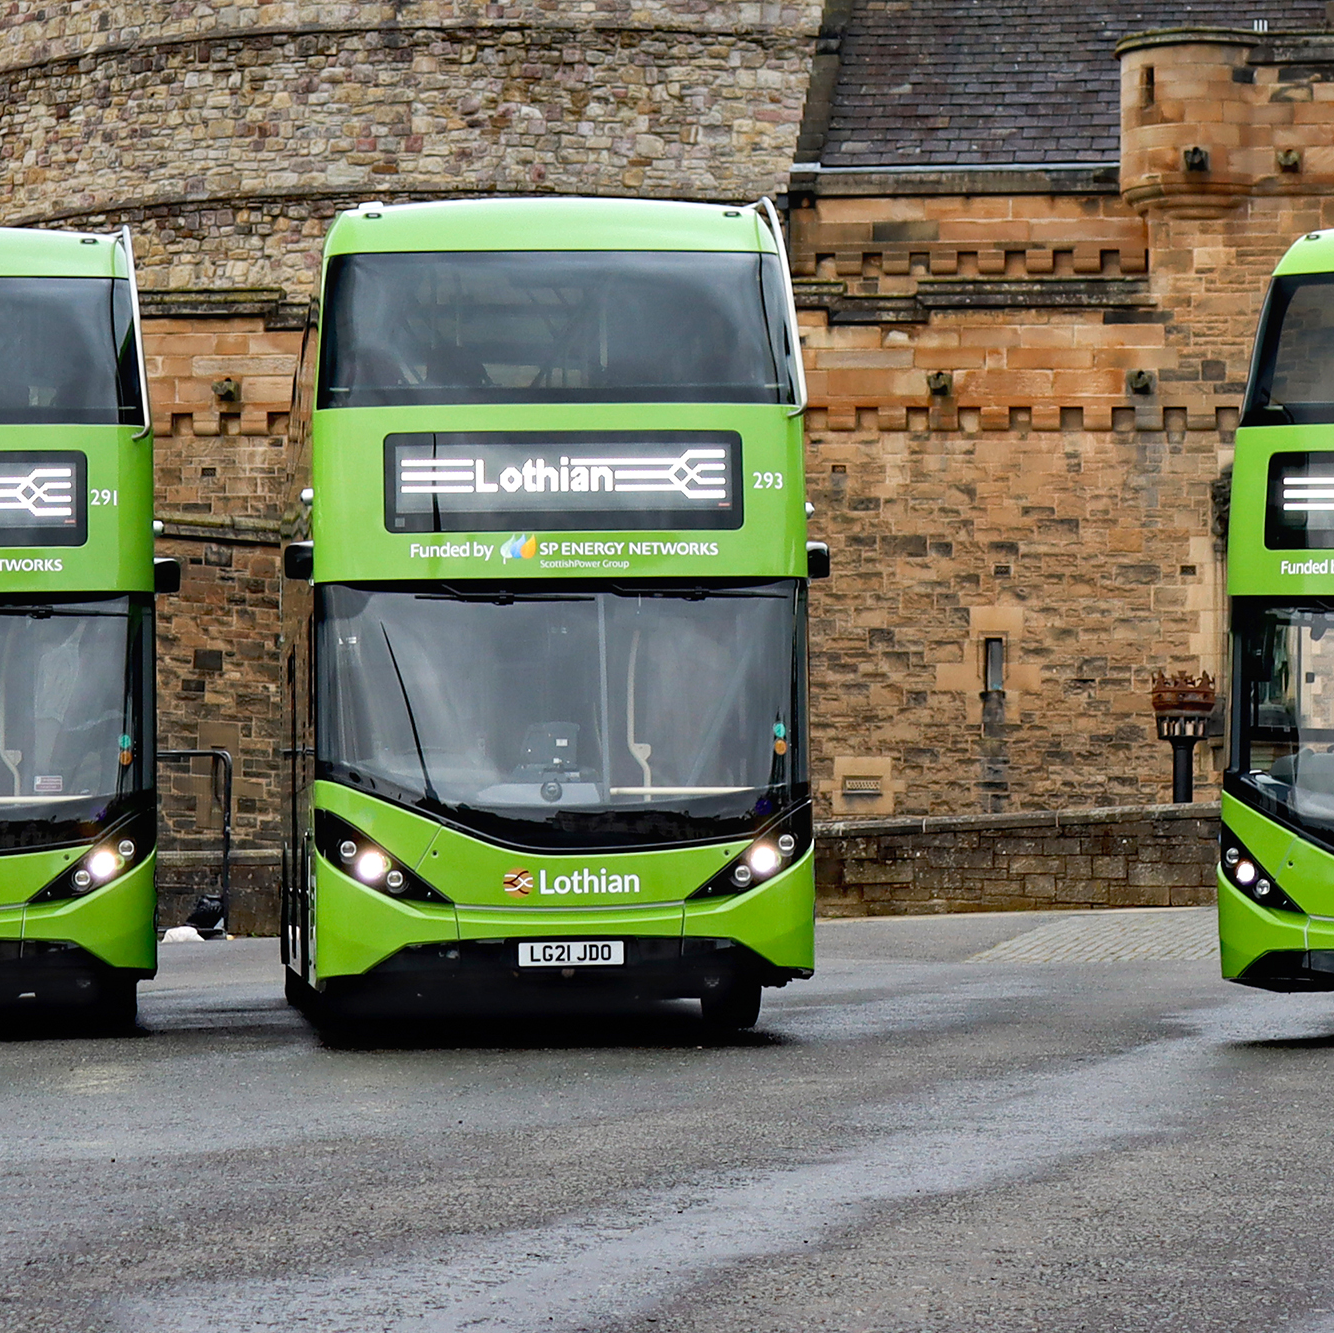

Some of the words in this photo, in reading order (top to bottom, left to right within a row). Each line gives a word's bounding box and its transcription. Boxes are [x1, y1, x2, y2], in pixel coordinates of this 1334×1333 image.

[475, 456, 616, 493] Lothian
[752, 471, 784, 490] 293
[90, 488, 119, 506] 291
[410, 541, 471, 558] Funded
[472, 541, 495, 562] by
[539, 541, 559, 556] SP
[560, 541, 626, 556] ENERGY
[628, 541, 719, 556] NETWORKS
[539, 559, 601, 569] ScottishPower
[601, 559, 630, 571] Group
[1280, 558, 1329, 575] Funded
[539, 867, 640, 895] Lothian
[530, 945, 571, 963] LG21
[577, 944, 612, 962] JDO
